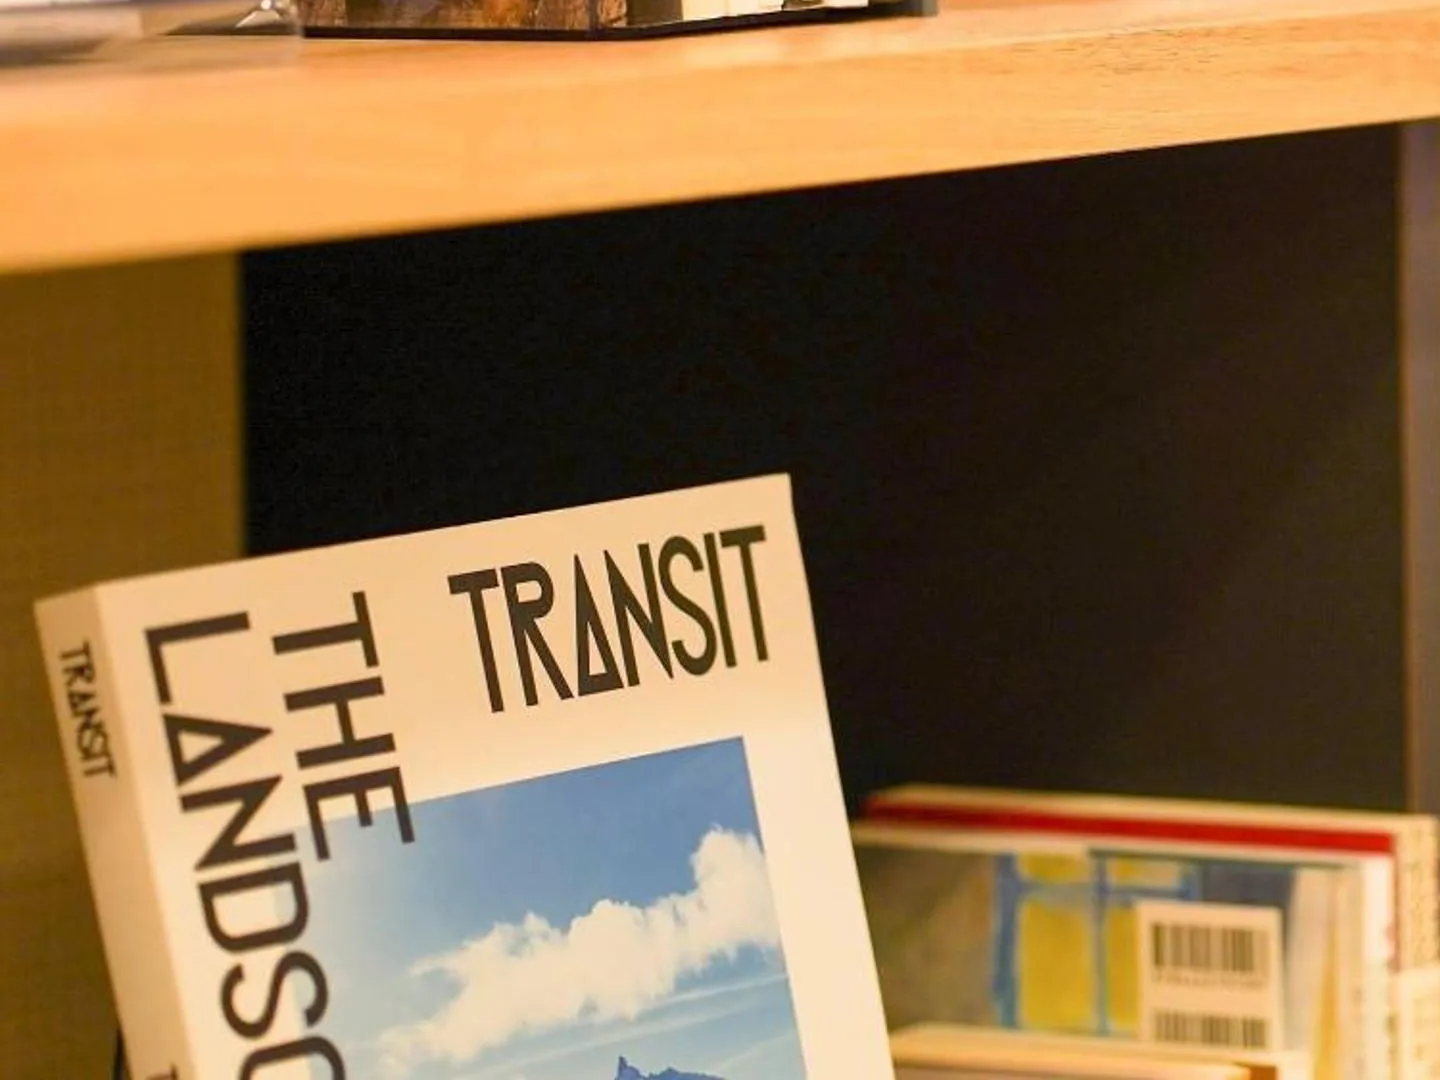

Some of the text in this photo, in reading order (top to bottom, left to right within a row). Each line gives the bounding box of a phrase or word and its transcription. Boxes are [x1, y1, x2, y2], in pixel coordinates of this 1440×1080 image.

[58, 640, 118, 782] TRANSIT
[447, 524, 770, 713] TRANSIT
[271, 590, 415, 862] THE
